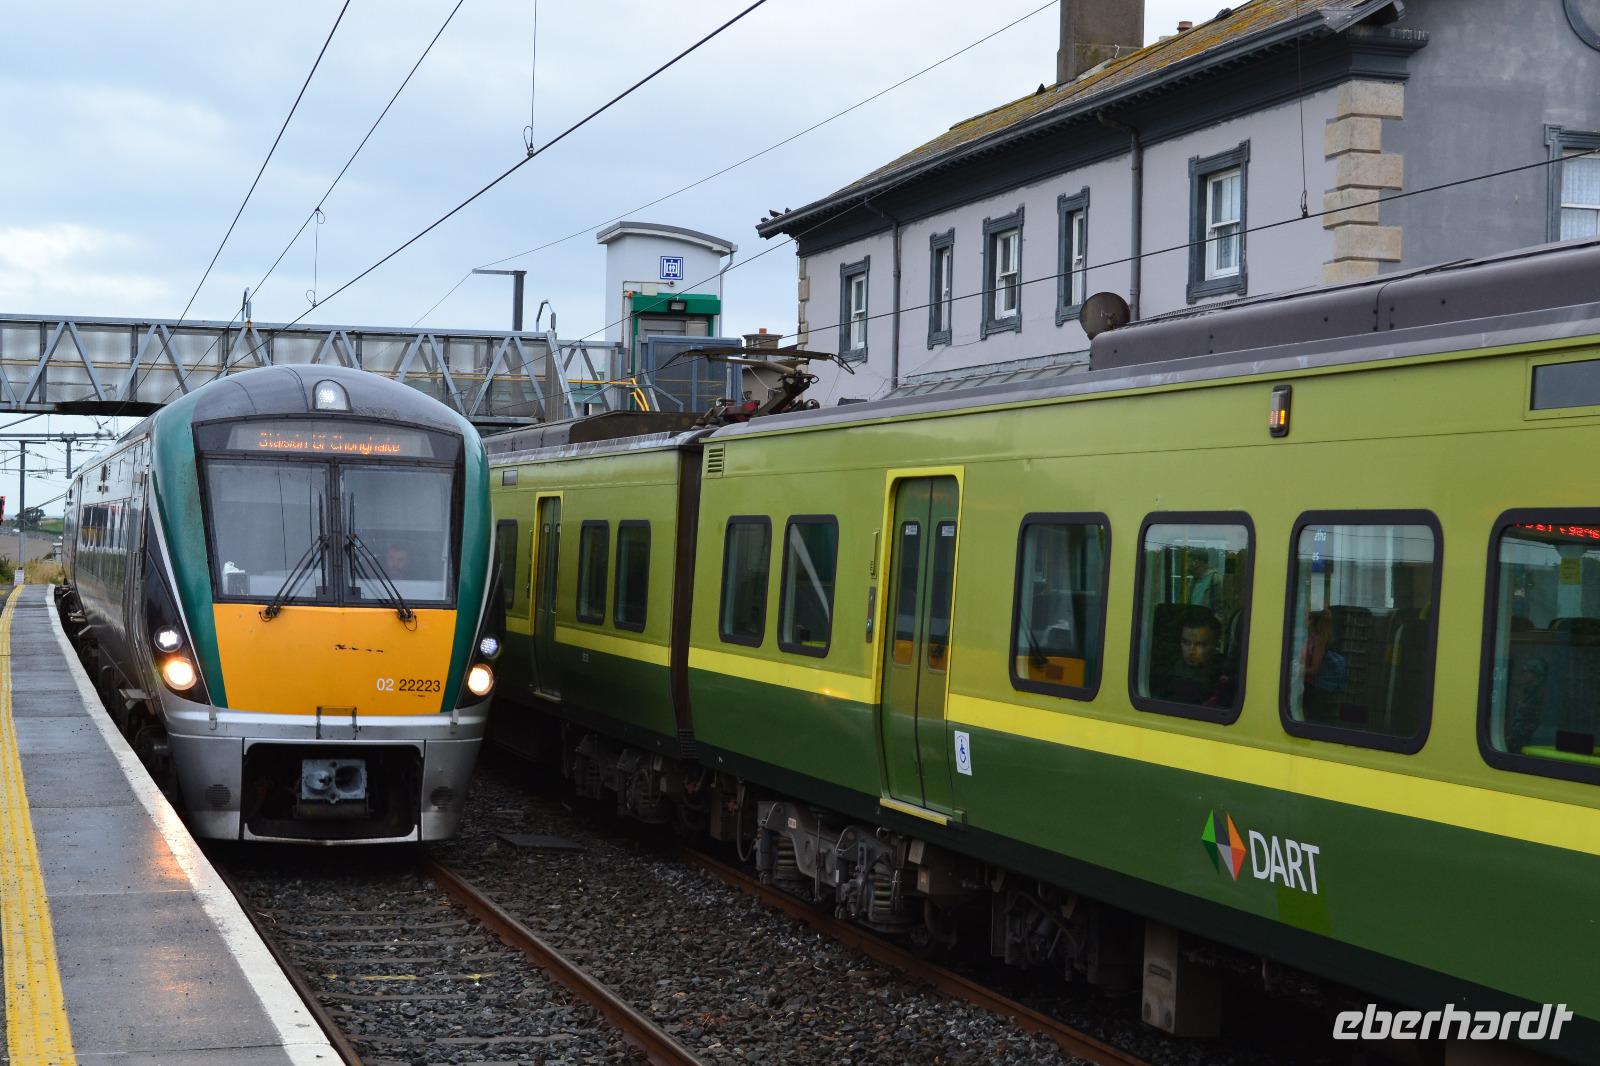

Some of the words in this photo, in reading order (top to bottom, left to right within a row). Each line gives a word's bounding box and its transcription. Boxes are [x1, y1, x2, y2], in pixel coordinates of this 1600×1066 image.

[376, 677, 394, 692] 02
[398, 678, 441, 693] 22223
[1248, 829, 1320, 895] DART
